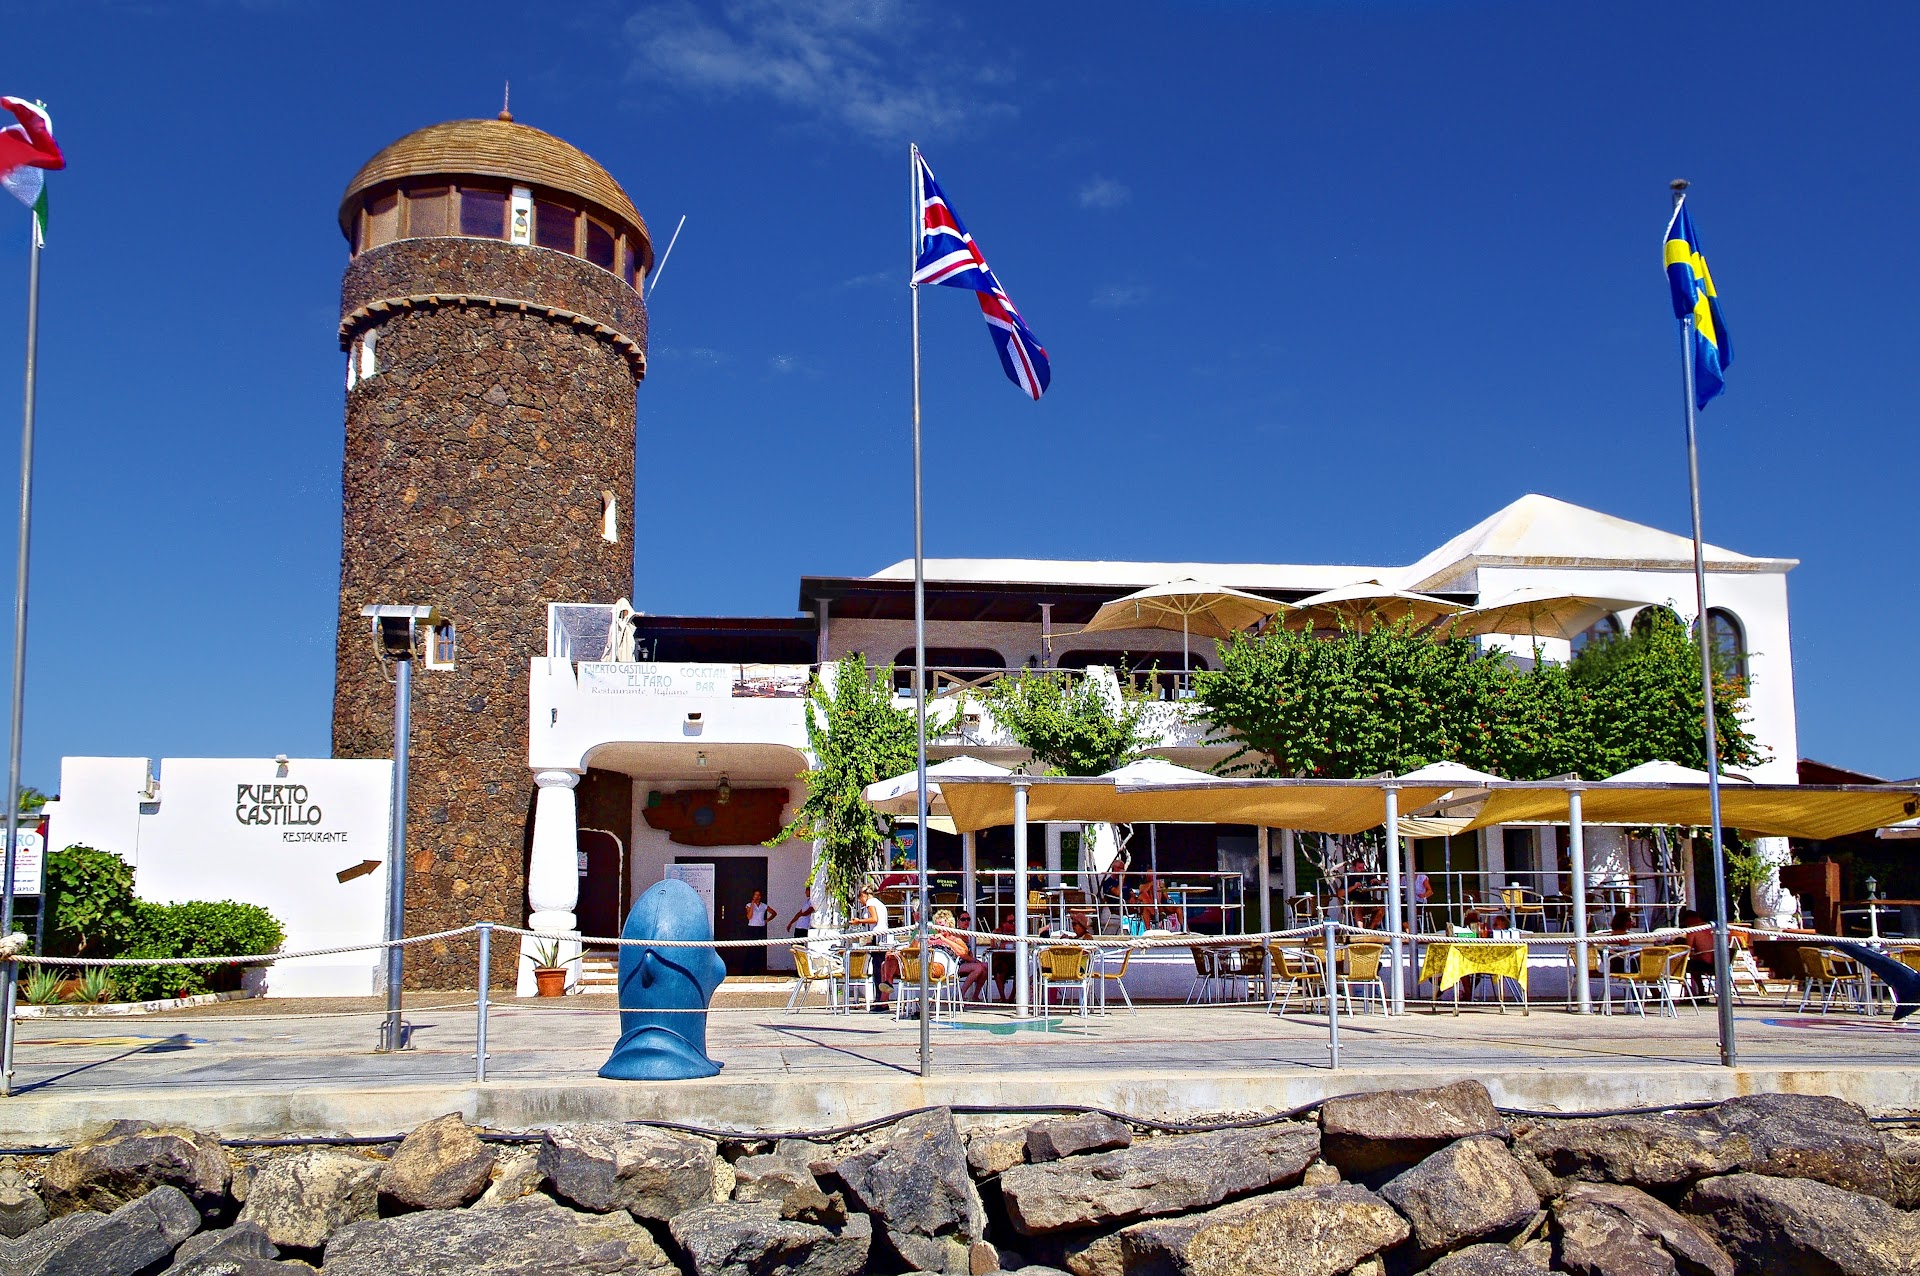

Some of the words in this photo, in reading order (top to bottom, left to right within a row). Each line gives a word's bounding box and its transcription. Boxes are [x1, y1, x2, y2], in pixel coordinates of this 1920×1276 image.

[584, 663, 617, 674] PUERTO
[618, 664, 657, 675] CASTILLO
[679, 667, 728, 679] COCKTAIL
[628, 675, 641, 687] EL
[643, 675, 672, 687] FARO
[695, 681, 715, 692] BAR
[237, 784, 308, 804] PUERTO
[236, 804, 322, 825] CASTILLO
[282, 831, 348, 843] RESTAURANTE
